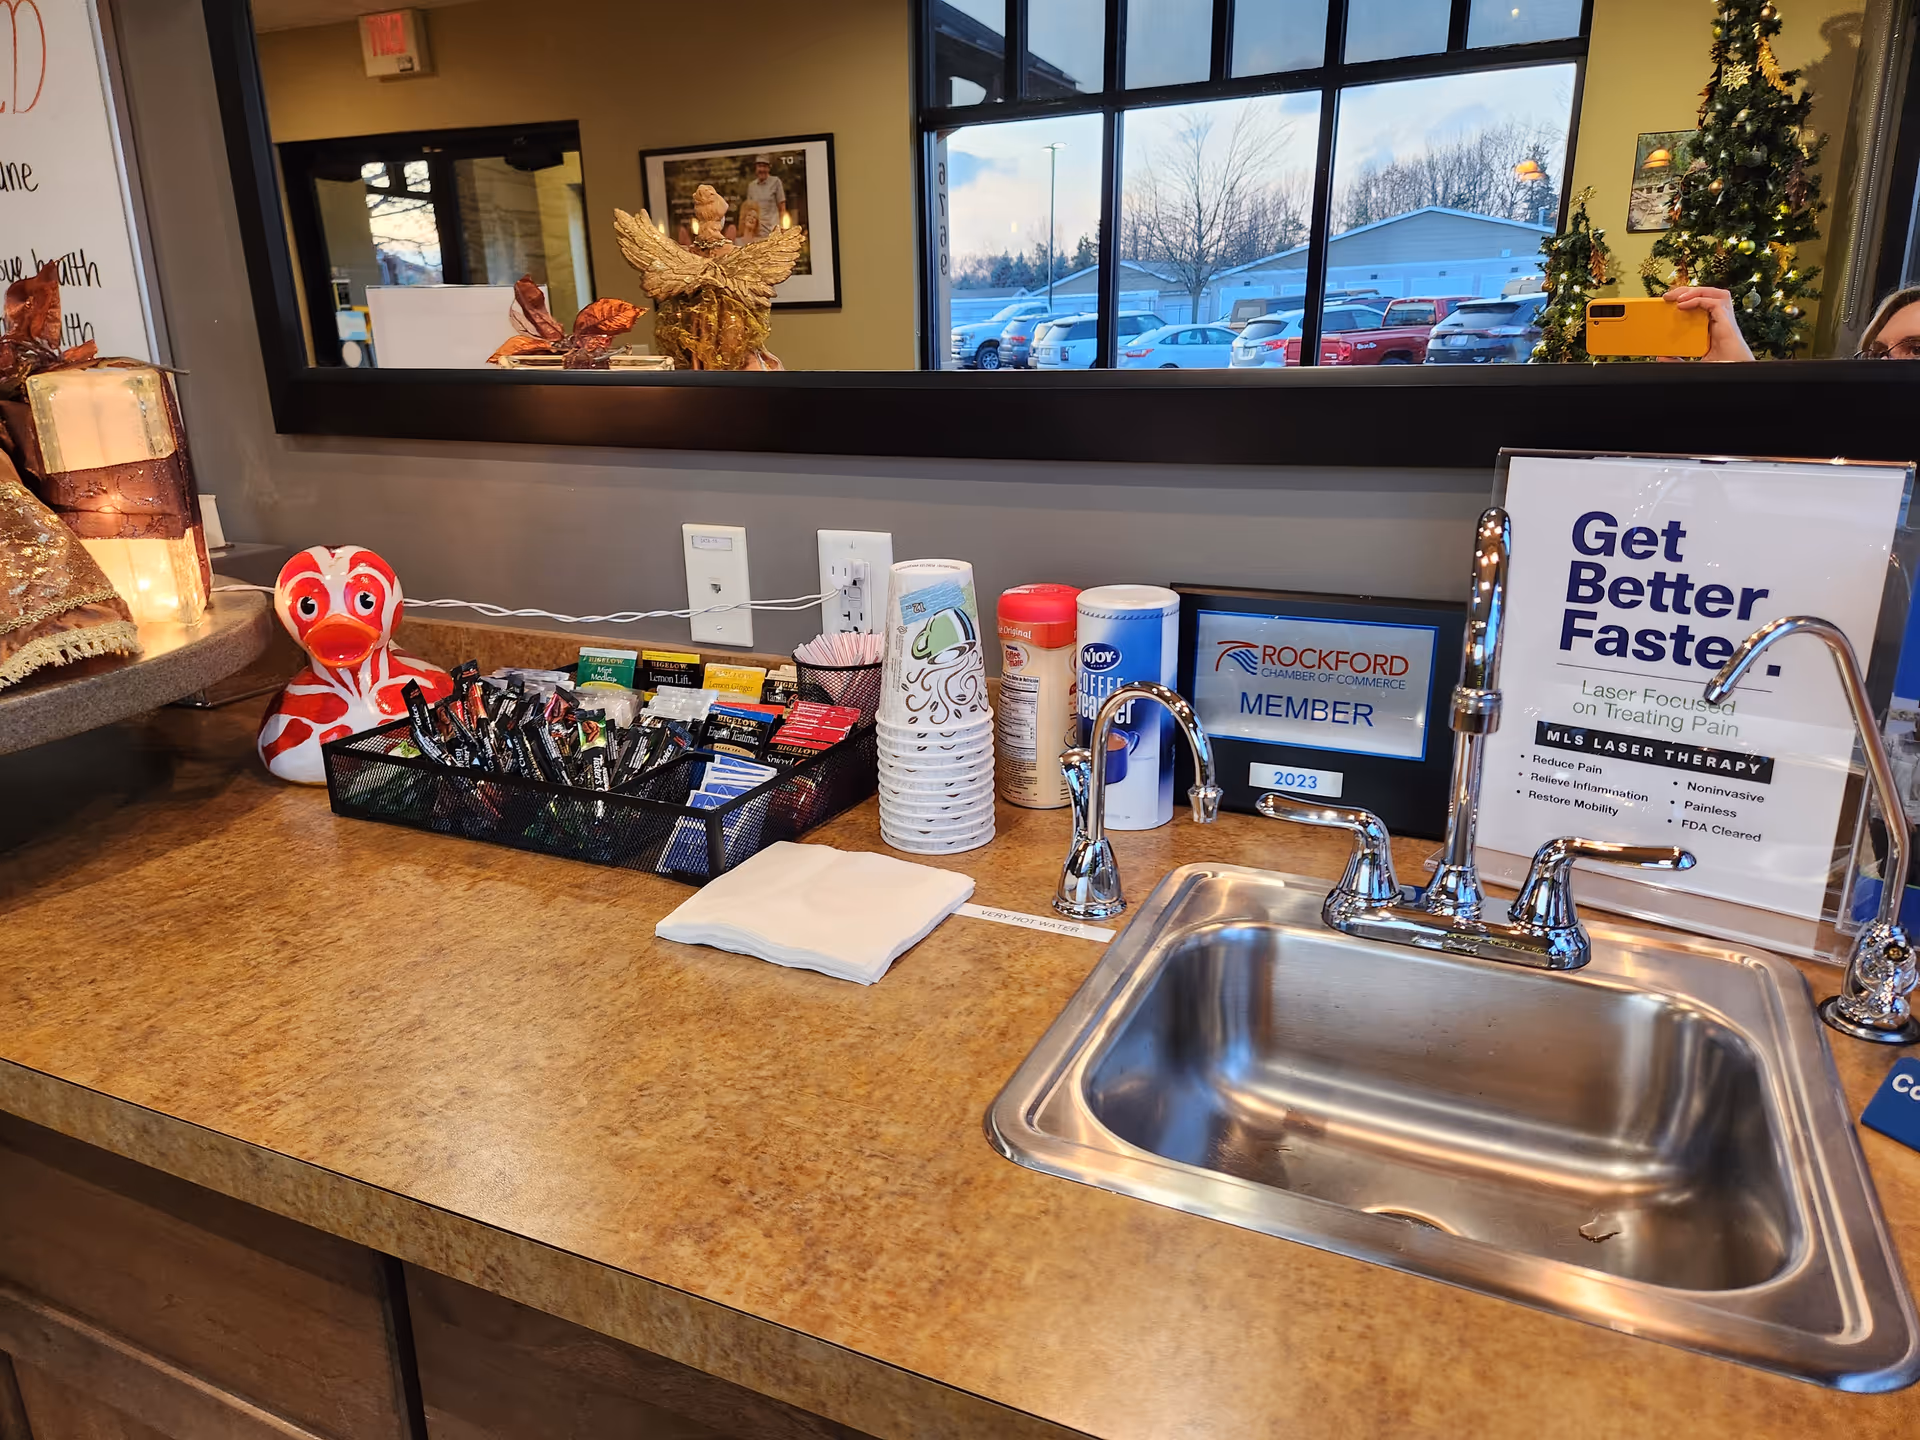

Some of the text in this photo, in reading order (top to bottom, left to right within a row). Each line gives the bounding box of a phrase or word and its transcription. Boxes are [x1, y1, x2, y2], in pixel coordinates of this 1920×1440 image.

[1571, 511, 1687, 562] Get
[1566, 560, 1769, 621] Better
[1003, 626, 1032, 639] Original
[1559, 608, 1781, 677] Faste.
[651, 660, 687, 669] BIGELOW
[1261, 644, 1410, 677] ROCKFORD
[591, 673, 616, 683] Medley
[649, 672, 674, 683] Lemon
[709, 681, 754, 693] Lemon Ginger
[774, 681, 799, 689] BIGEL
[1261, 667, 1407, 690] CHAMBER OF COMMERCE
[1239, 691, 1374, 727] MEMBER
[1582, 680, 1736, 716] Laser Focused
[717, 715, 758, 727] BIGELOW
[1572, 701, 1739, 737] on Treating Pain
[776, 744, 820, 756] BIGELOW
[1546, 730, 1760, 775] MLS LASER THERAPY
[1533, 754, 1602, 775] Reduce Pain
[1273, 771, 1318, 789] 2023
[1530, 772, 1649, 802] Relieve Inflammation
[1528, 790, 1619, 816] Restore Mobility
[1687, 781, 1765, 803] Noninvasive
[1684, 800, 1737, 818] Painless
[1681, 819, 1762, 842] FDA Cleared
[981, 910, 1080, 933] VERY HOT WATER
